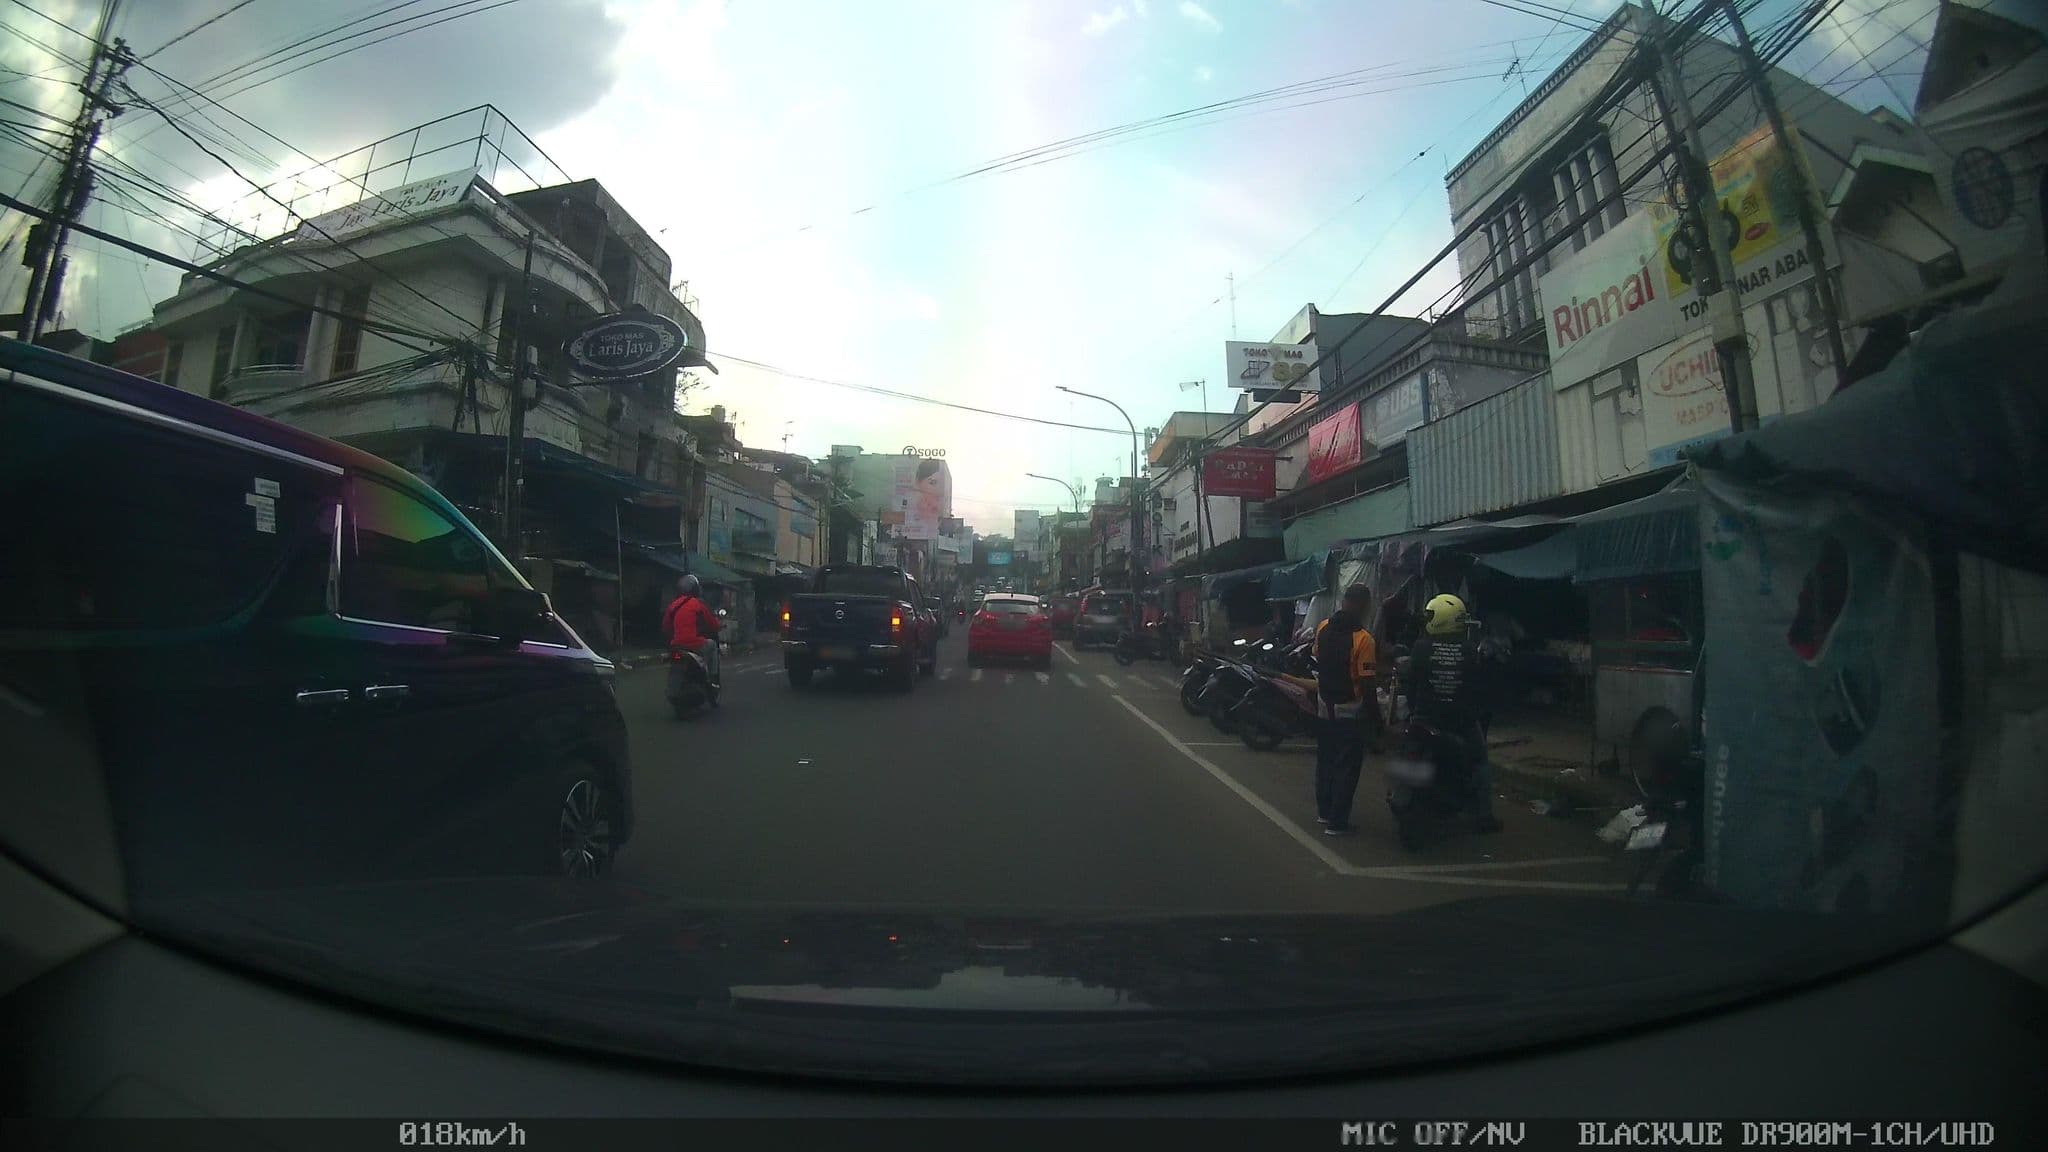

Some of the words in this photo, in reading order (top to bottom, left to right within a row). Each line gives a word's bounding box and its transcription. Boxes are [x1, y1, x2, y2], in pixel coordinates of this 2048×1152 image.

[417, 184, 460, 206] Jaya
[1736, 266, 1772, 296] NAR
[1775, 248, 1809, 279] ABA
[1552, 254, 1656, 349] Rinnai
[1679, 296, 1709, 321] TOK
[589, 340, 624, 358] Laris
[625, 338, 654, 359] Jaya
[917, 447, 946, 458] SOGO
